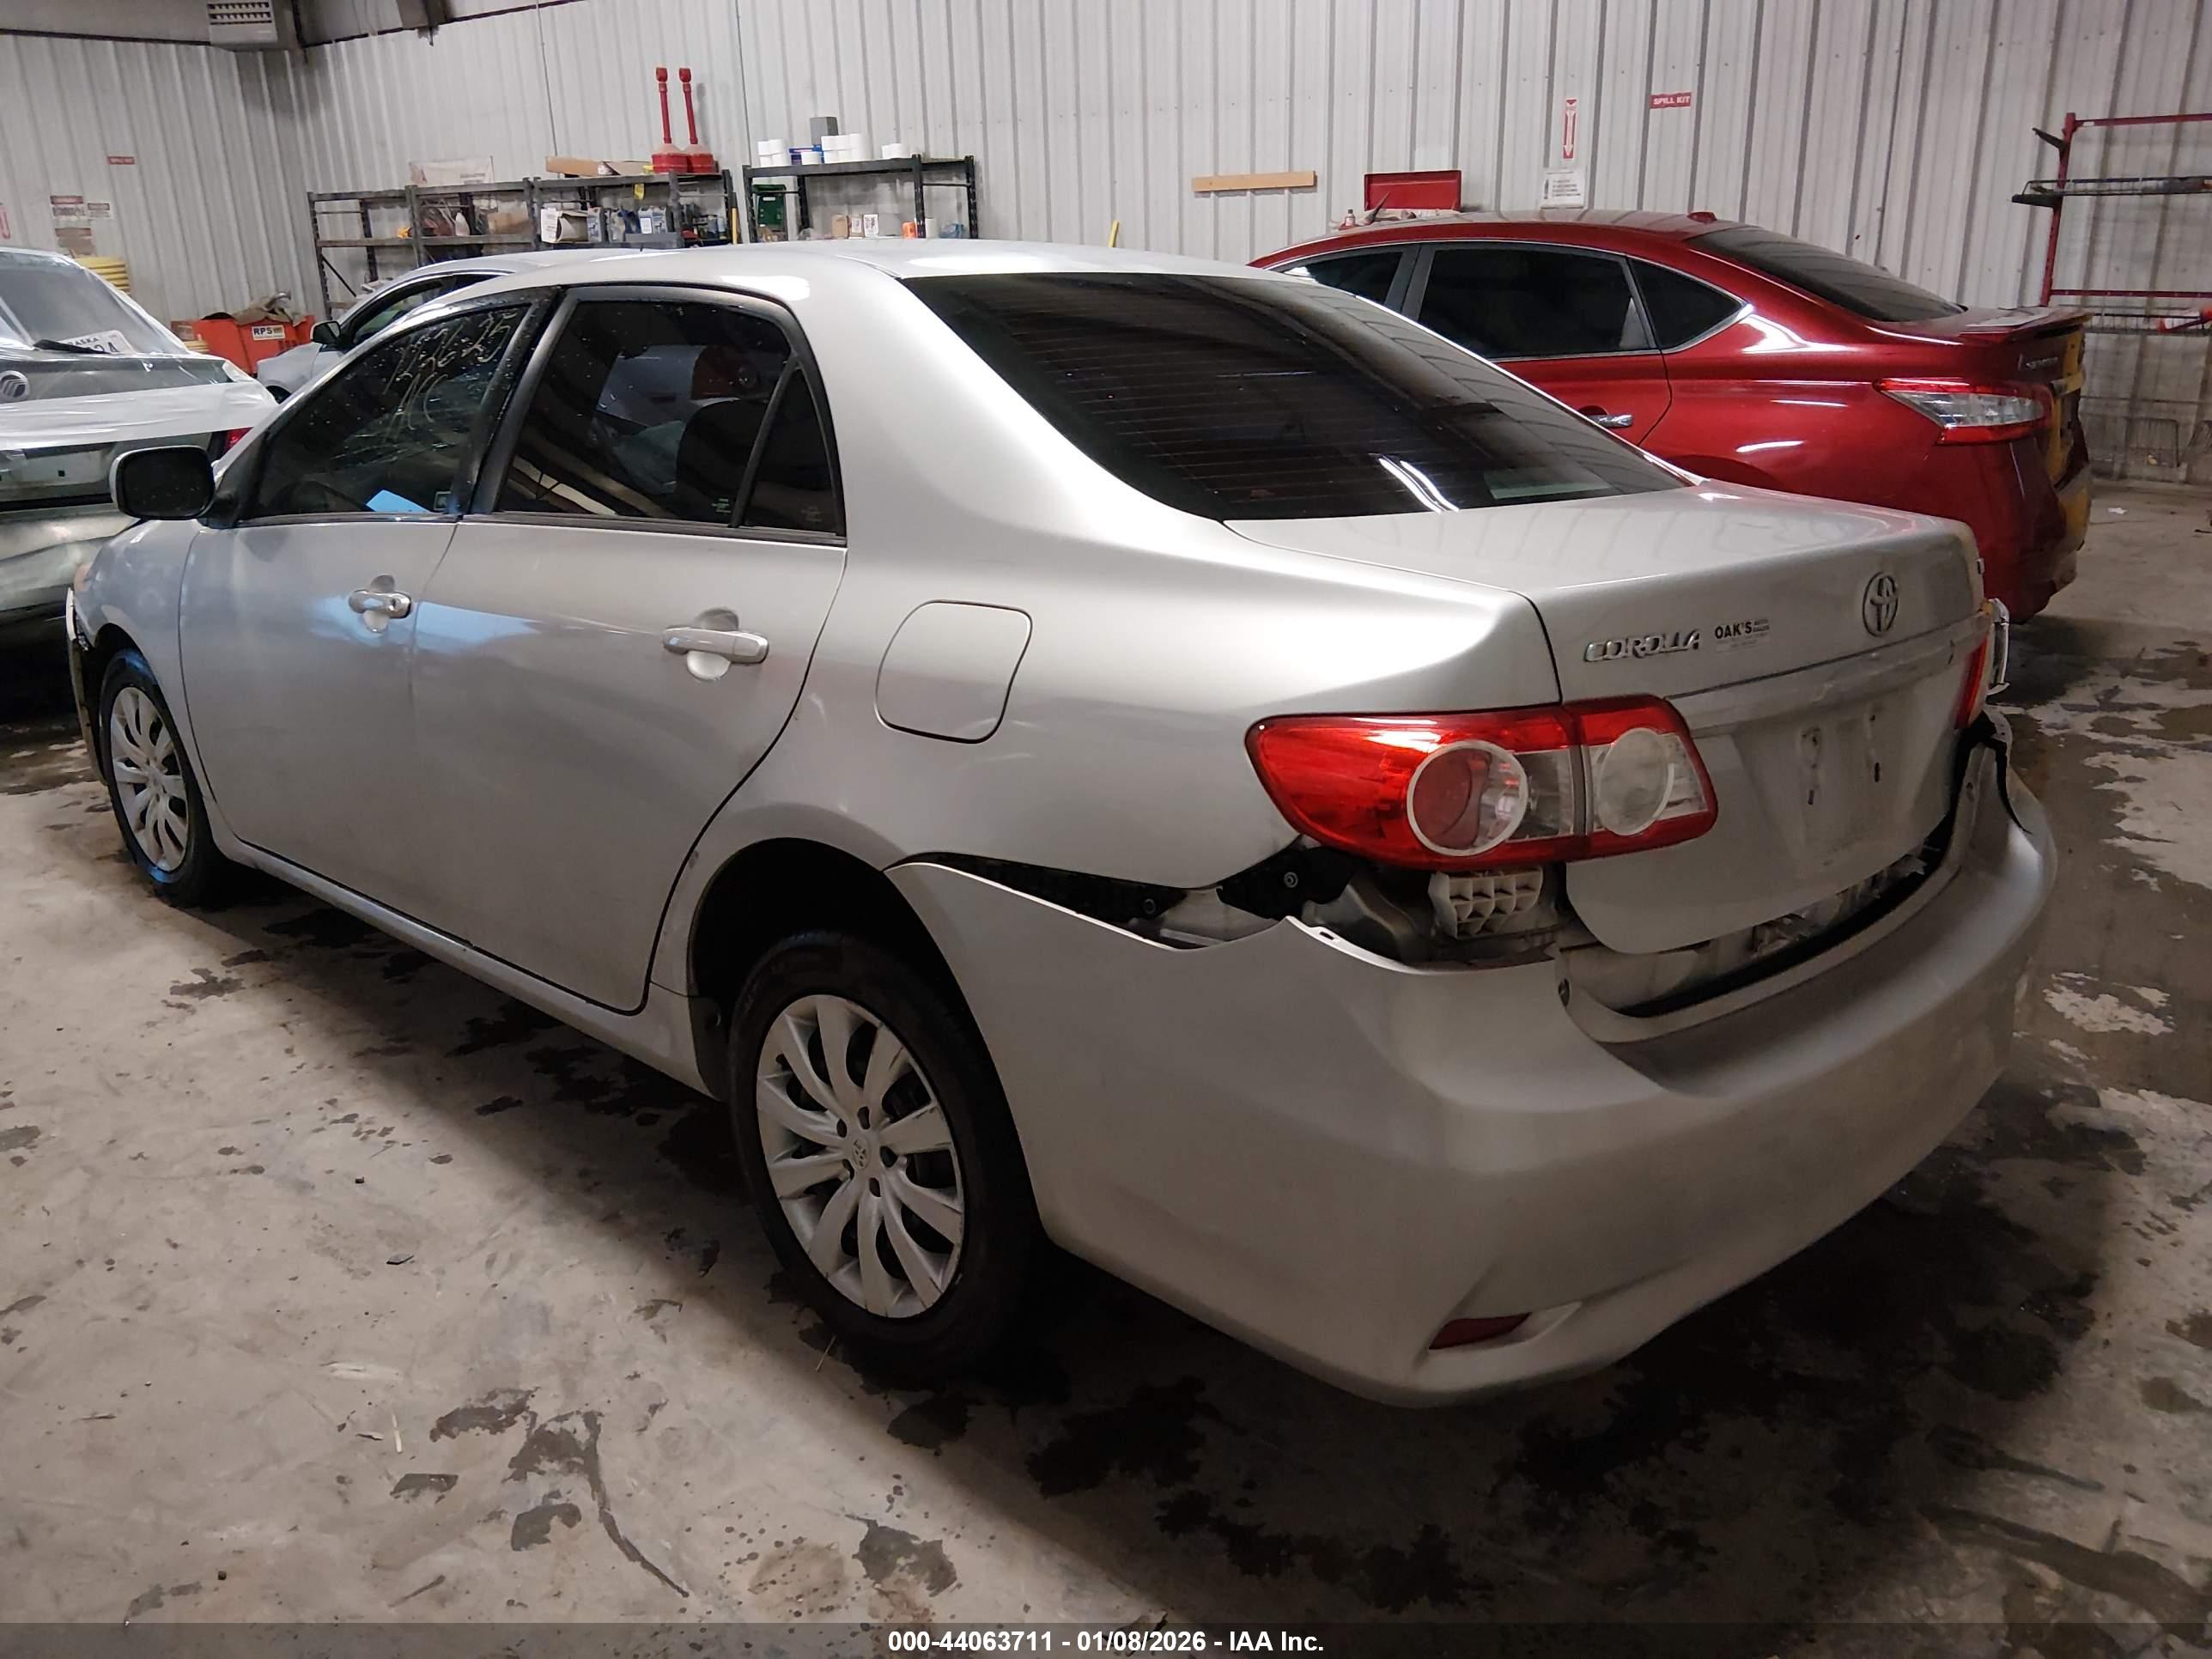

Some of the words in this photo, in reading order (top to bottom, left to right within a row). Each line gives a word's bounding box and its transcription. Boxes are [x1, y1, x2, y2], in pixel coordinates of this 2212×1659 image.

[1676, 95, 1691, 104] KIT
[253, 327, 273, 336] RPS
[1715, 621, 1753, 640] OAK'S
[1584, 629, 1700, 663] COROLLA
